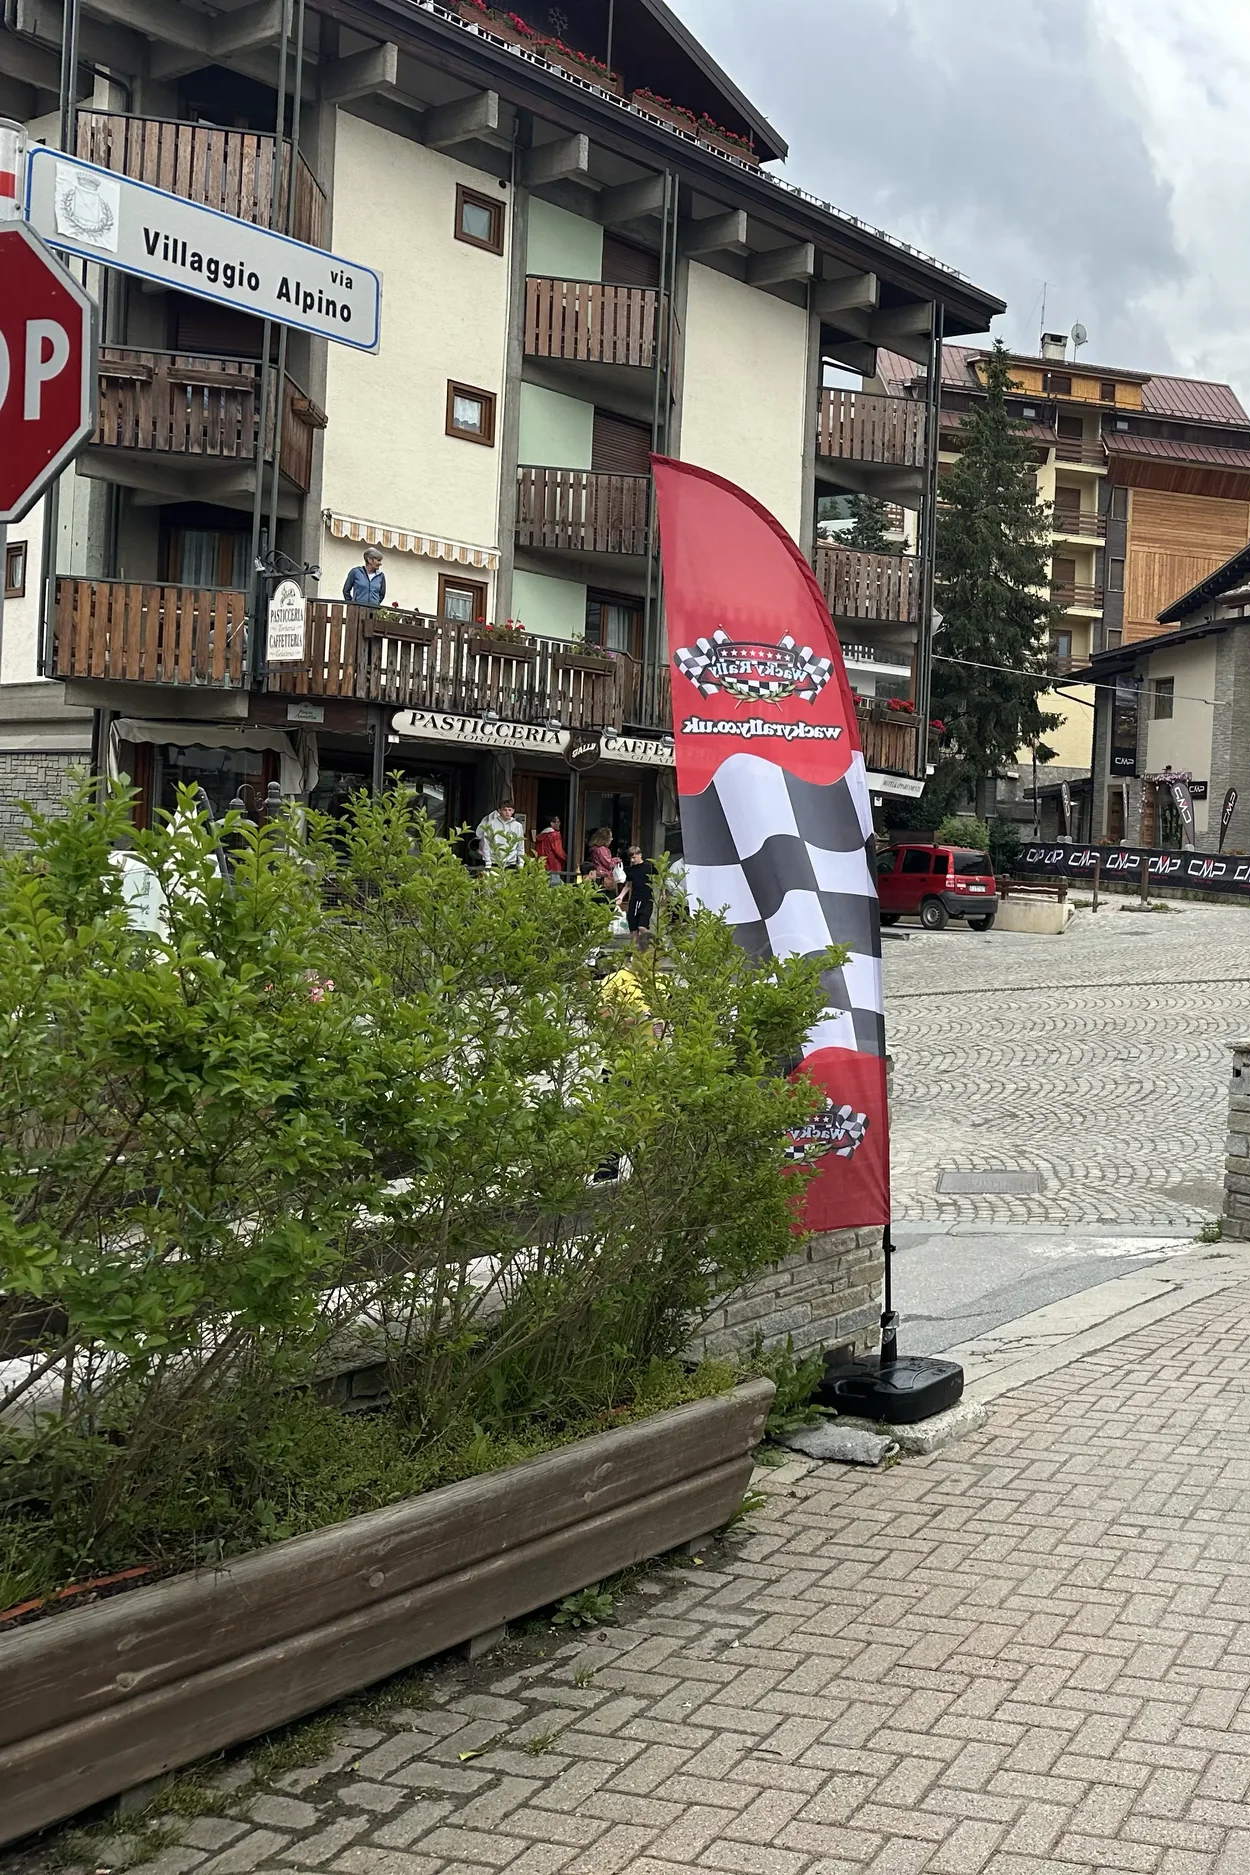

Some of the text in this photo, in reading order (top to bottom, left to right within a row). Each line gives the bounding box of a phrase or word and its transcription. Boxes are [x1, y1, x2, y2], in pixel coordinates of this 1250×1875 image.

[143, 227, 352, 323] Villaggio Alpino
[330, 270, 354, 290] via
[270, 607, 303, 623] PASTICCERIA
[269, 633, 303, 649] CAFFETTERIA
[409, 711, 562, 745] PASTICCERIA
[455, 732, 526, 748] TORTERIA
[1115, 757, 1134, 765] CMP
[1188, 785, 1205, 793] CMP
[1174, 786, 1192, 824] CMP
[1222, 791, 1236, 825] CMP
[1068, 850, 1100, 867] CMP
[1106, 851, 1140, 870] CMP
[1148, 855, 1182, 874] CMP
[1187, 859, 1227, 878] CMP
